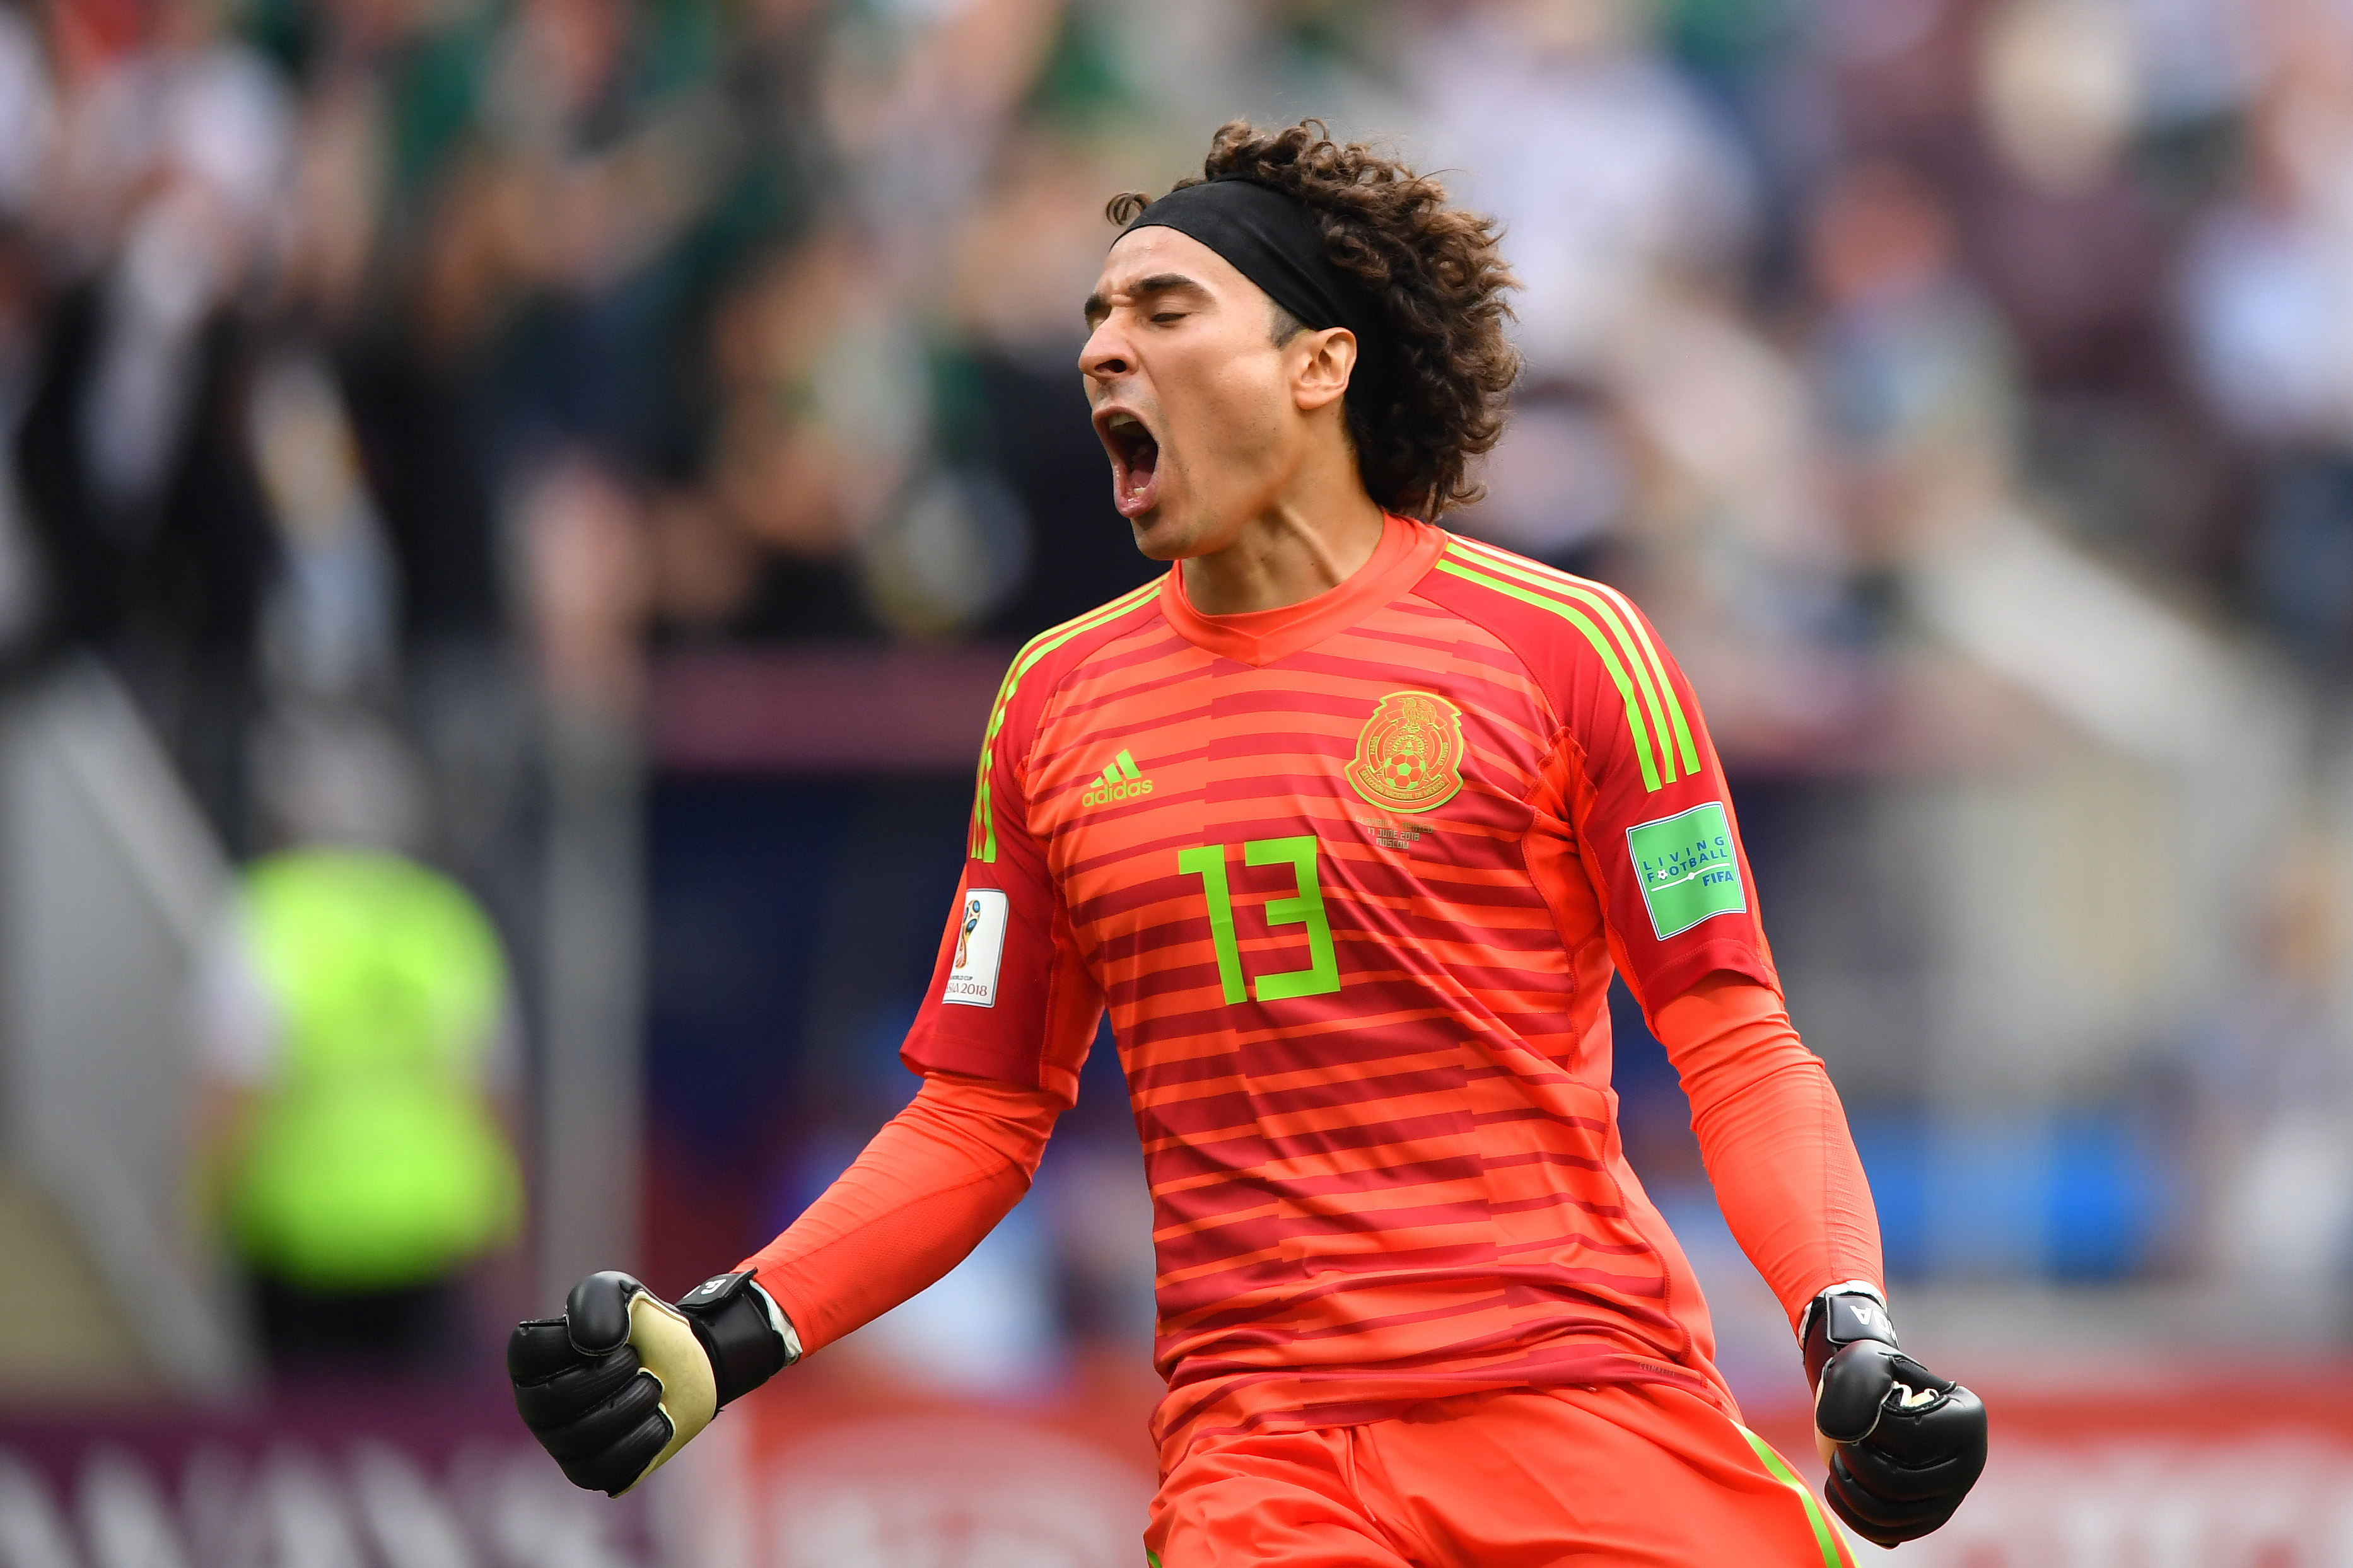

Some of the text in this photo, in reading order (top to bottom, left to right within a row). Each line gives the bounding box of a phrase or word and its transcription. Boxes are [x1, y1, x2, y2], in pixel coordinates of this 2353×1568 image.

[1082, 780, 1153, 807] adidas
[1367, 827, 1420, 841] 17 JUNE 2018
[1376, 838, 1410, 849] MOSCOW
[1643, 836, 1725, 871] LIVING
[1702, 871, 1734, 886] FIFA
[1178, 835, 1341, 1005] 13
[960, 983, 988, 996] 2018
